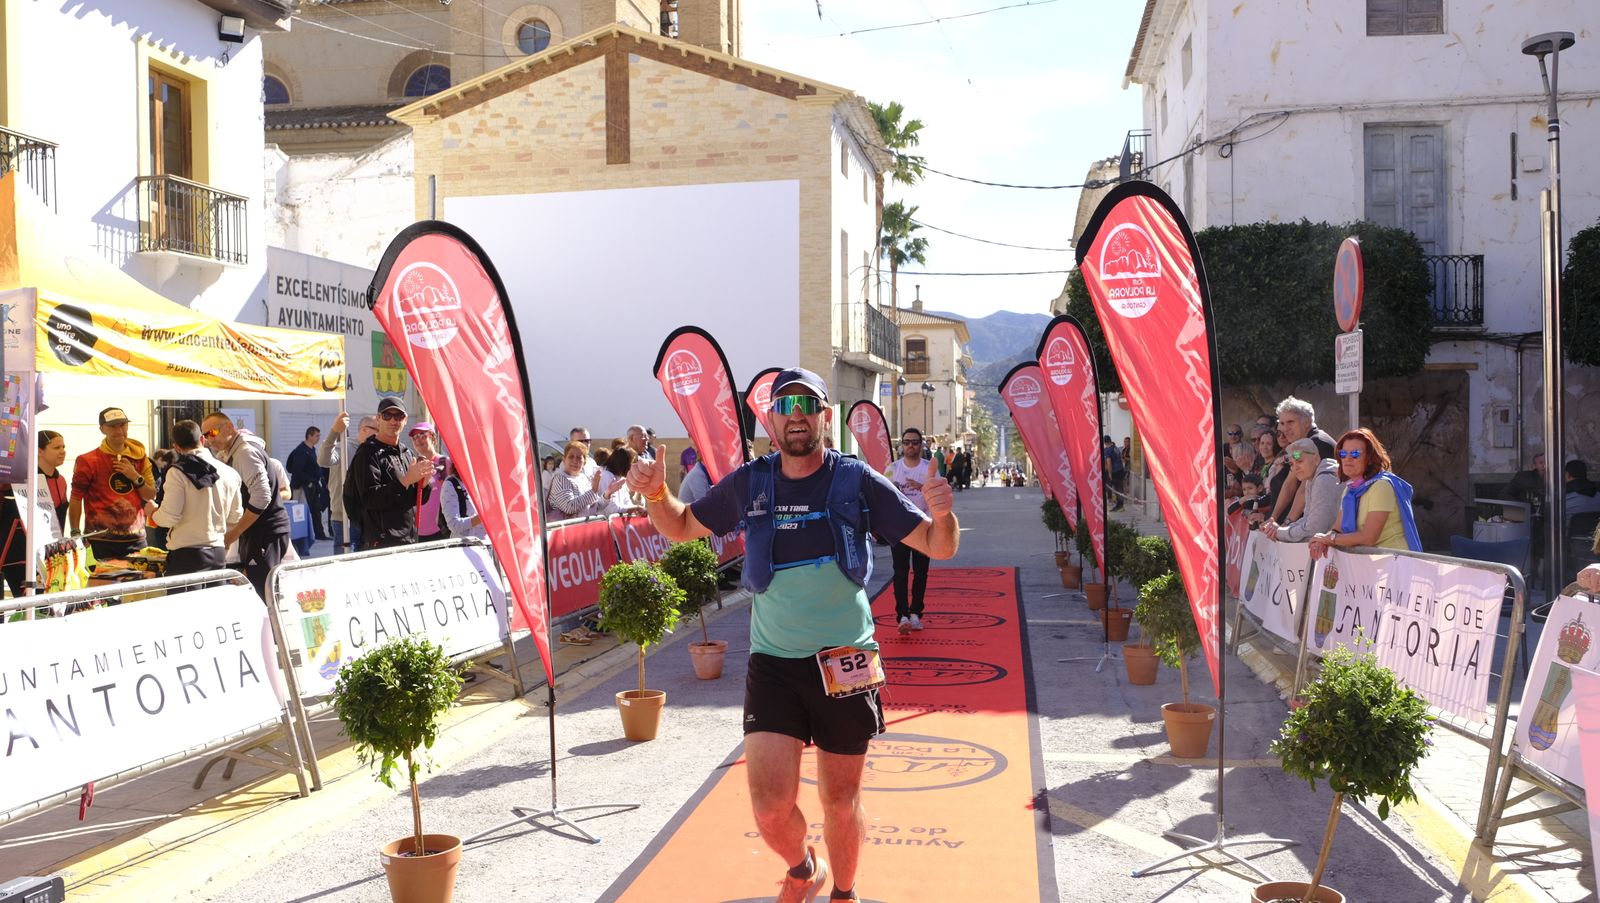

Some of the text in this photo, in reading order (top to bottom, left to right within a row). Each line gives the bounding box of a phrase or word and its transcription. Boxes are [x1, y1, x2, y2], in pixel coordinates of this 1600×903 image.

[276, 275, 366, 309] EXCELENTÍSIMO
[56, 322, 72, 331] uno
[278, 306, 364, 336] AYUNTAMIENTO
[549, 548, 605, 591] VEOLIA
[348, 589, 498, 648] CANTORIA
[1463, 606, 1484, 629] DE
[215, 622, 244, 645] DE
[1335, 605, 1481, 680] CANTORIA
[840, 653, 868, 673] 52
